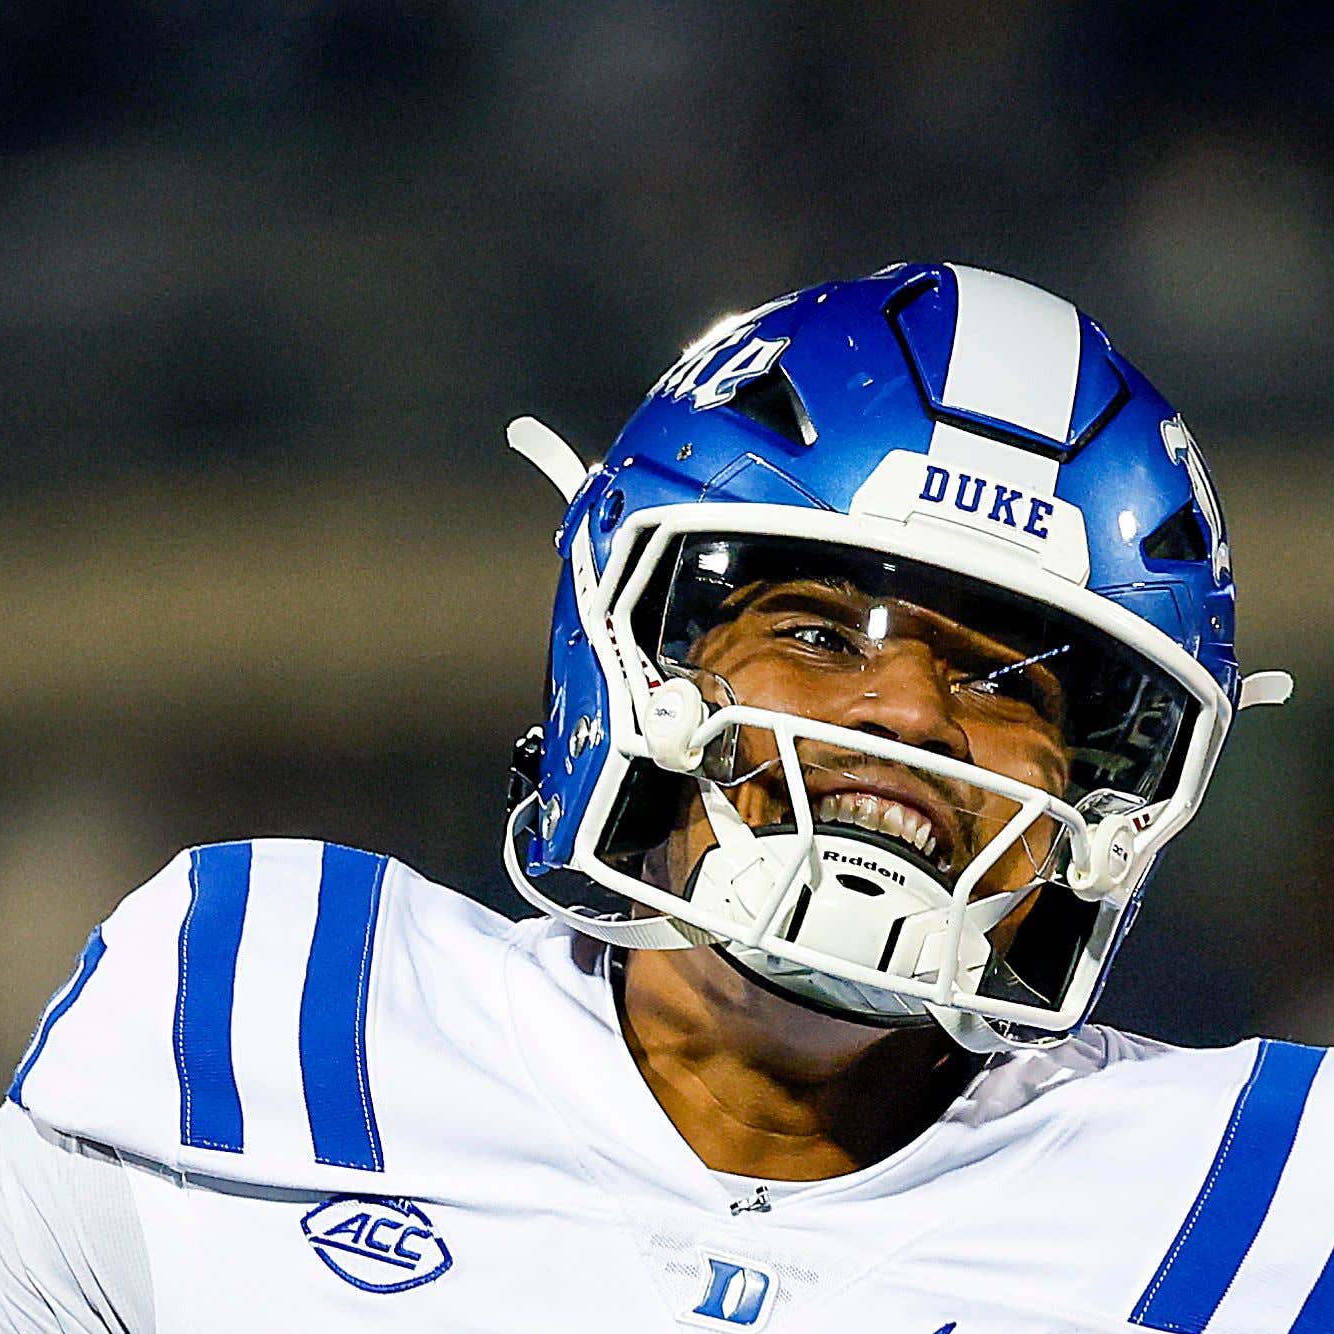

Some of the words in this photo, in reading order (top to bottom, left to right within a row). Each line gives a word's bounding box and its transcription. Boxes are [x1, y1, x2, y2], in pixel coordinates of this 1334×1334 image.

[919, 465, 1054, 539] DUKE
[823, 851, 906, 886] Riddell
[323, 1212, 435, 1261] ACC
[691, 1257, 771, 1327] D
